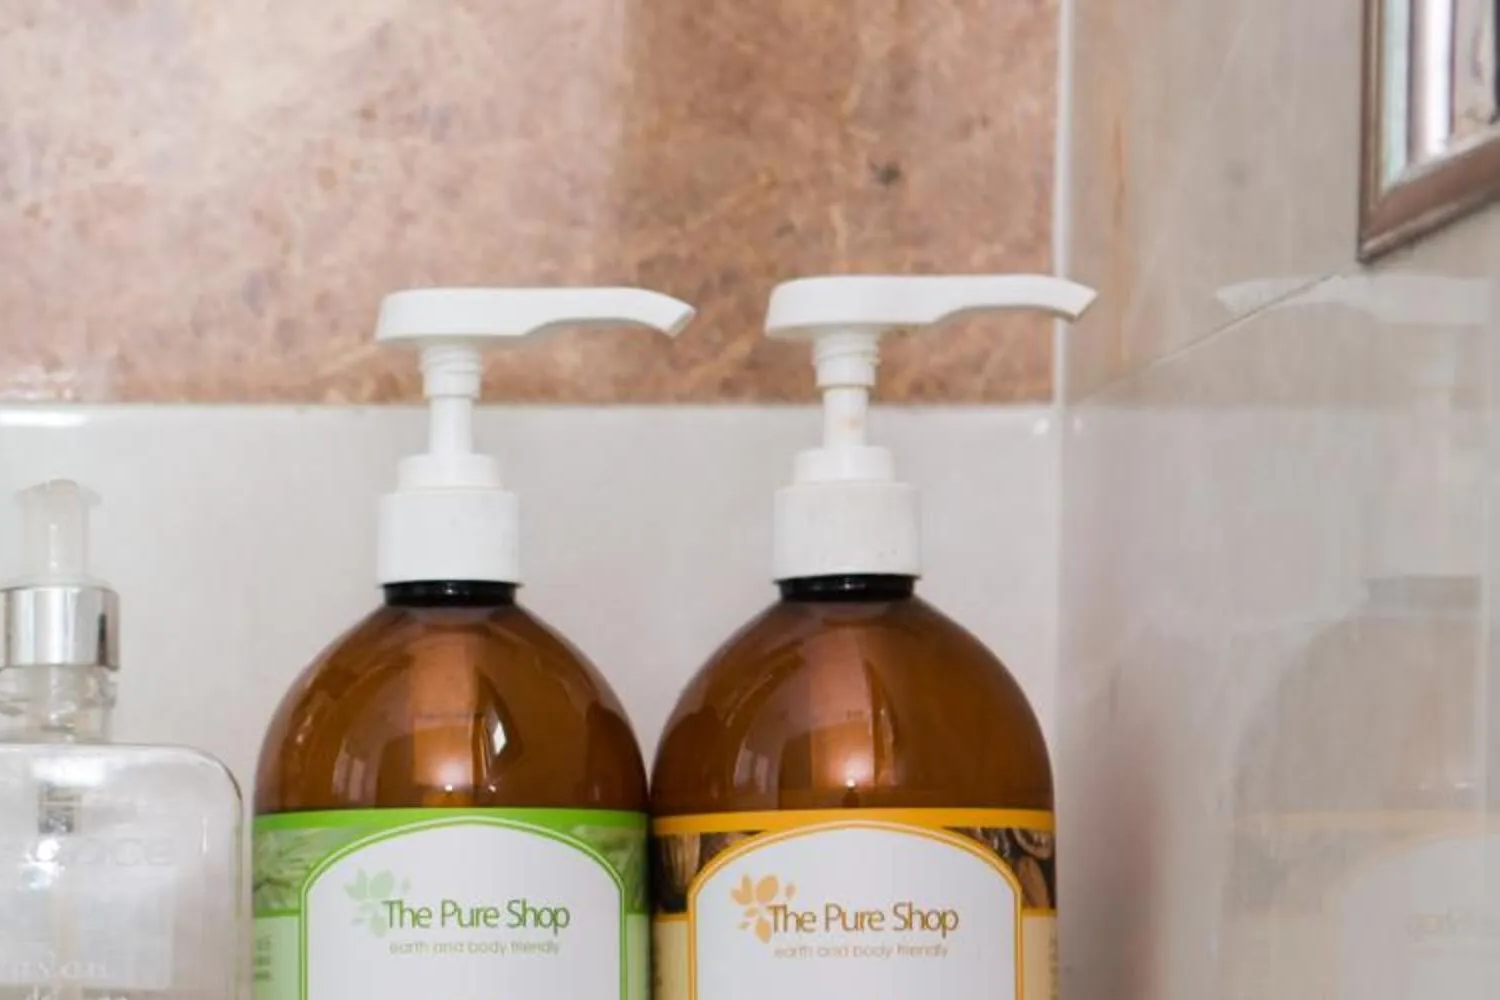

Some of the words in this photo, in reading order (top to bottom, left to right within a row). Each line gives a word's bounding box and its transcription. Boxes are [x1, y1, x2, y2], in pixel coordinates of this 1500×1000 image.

[383, 899, 433, 929] The
[440, 899, 500, 929] Pure
[506, 898, 571, 935] Shop
[767, 903, 817, 933] The
[824, 902, 885, 932] Pure
[892, 901, 960, 939] Shop
[389, 939, 430, 954] earth
[433, 939, 464, 954] and
[467, 939, 507, 957] body
[510, 939, 561, 957] friendly
[773, 943, 813, 958] earth
[816, 943, 849, 958] and
[853, 943, 894, 961] body
[897, 942, 948, 960] friendly
